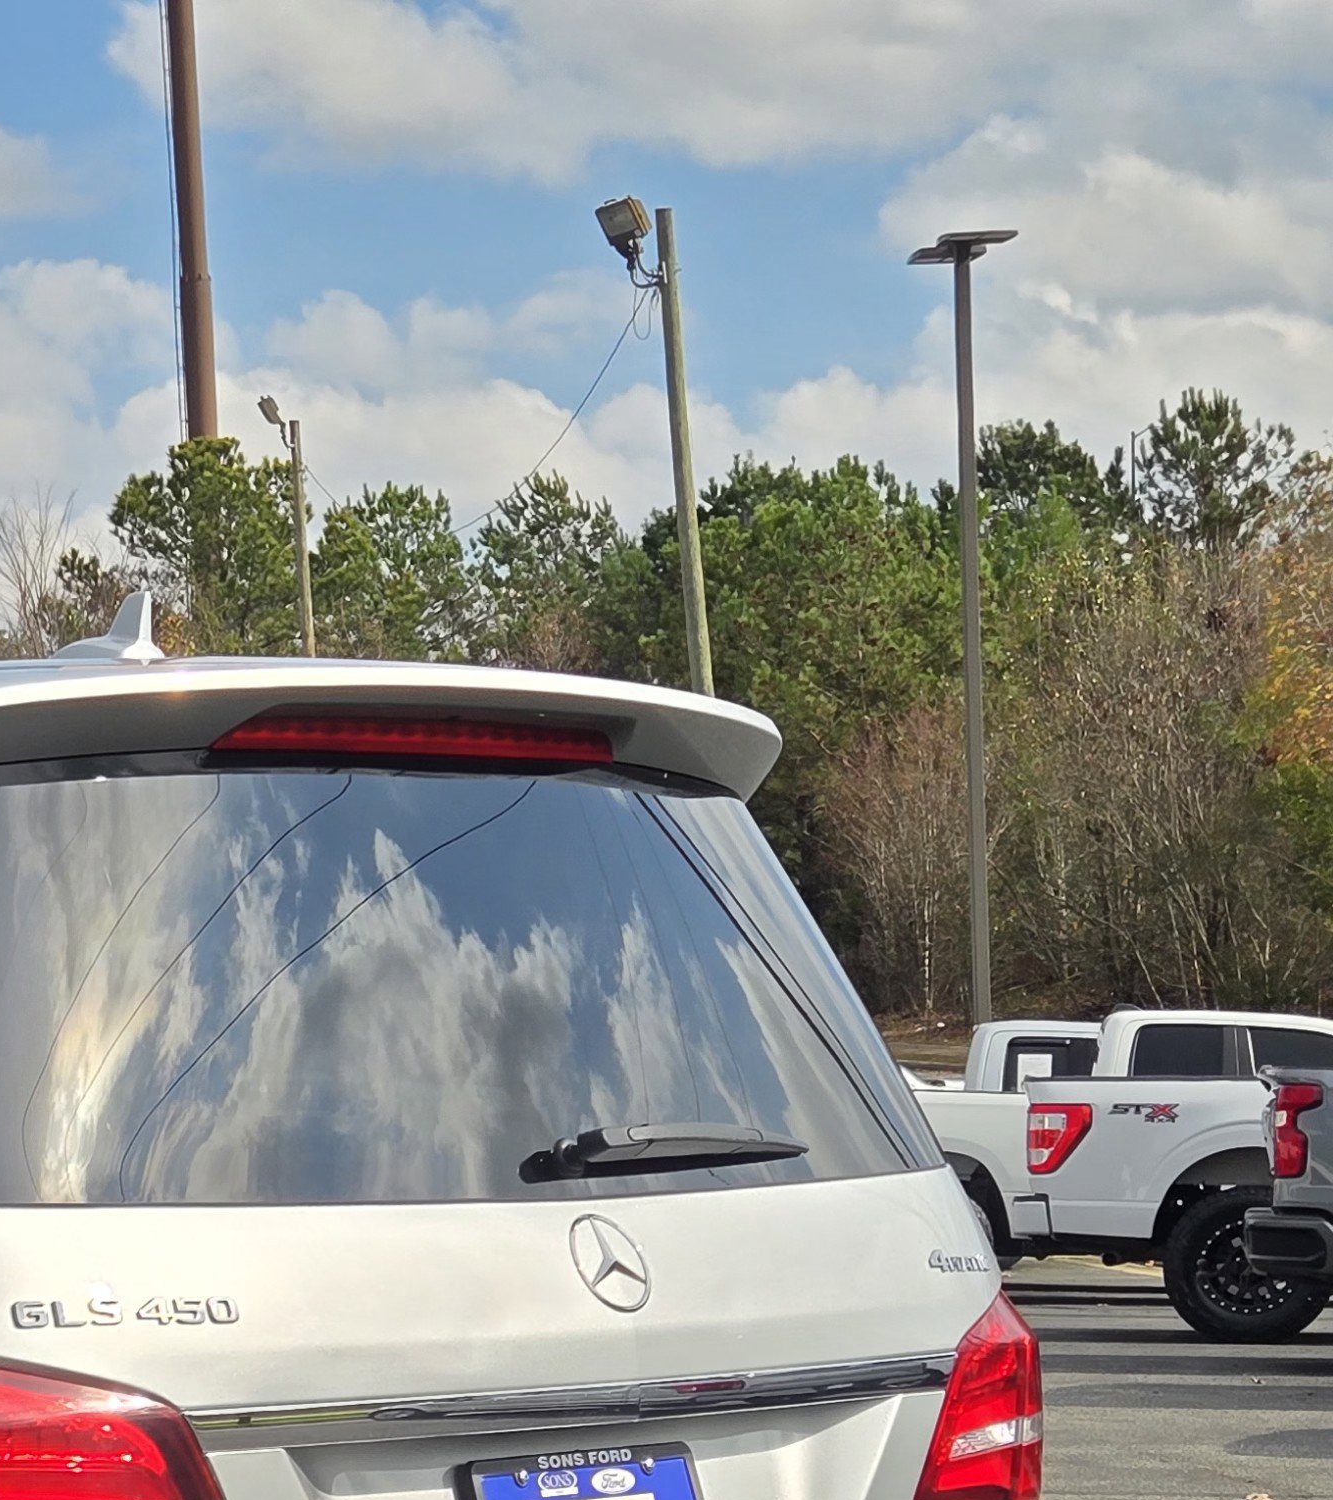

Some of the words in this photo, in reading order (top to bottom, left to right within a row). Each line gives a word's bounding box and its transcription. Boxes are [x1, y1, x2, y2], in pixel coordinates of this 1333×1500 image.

[1108, 1103, 1180, 1118] STX
[11, 1296, 124, 1330] GLS
[136, 1295, 240, 1326] 450
[537, 1452, 585, 1469] SONS
[588, 1448, 632, 1464] FORD
[601, 1473, 626, 1489] Ford
